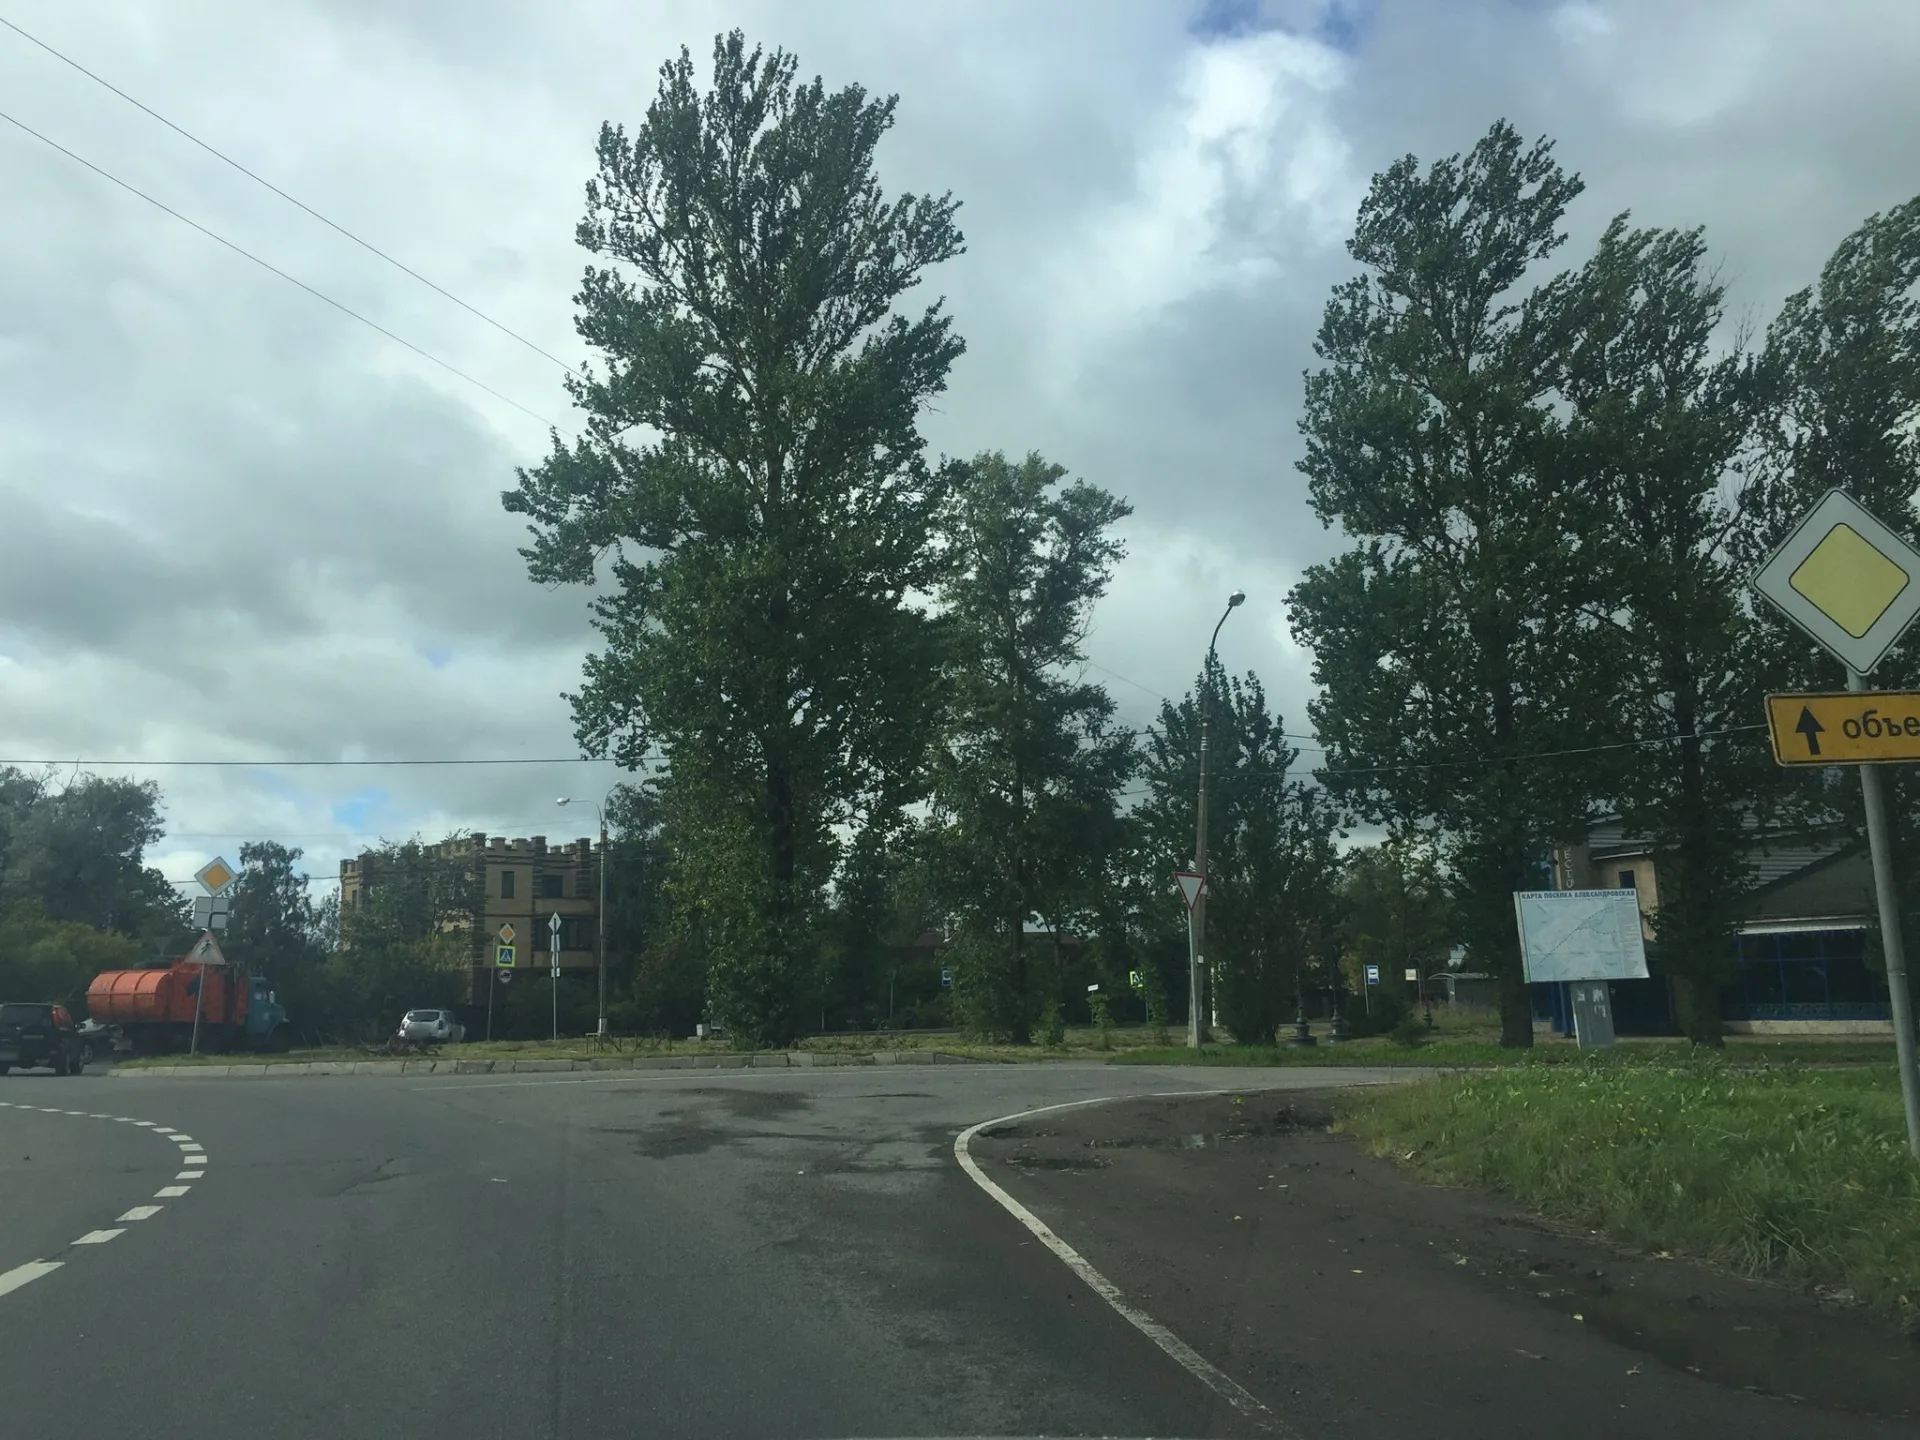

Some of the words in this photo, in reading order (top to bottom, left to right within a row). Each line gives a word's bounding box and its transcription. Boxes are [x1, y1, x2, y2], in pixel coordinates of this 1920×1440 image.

[1842, 709, 1920, 739] объе
[1522, 892, 1543, 900] КАРТА
[1574, 890, 1635, 898] АЛЕКСАНДРОВСКАЯ
